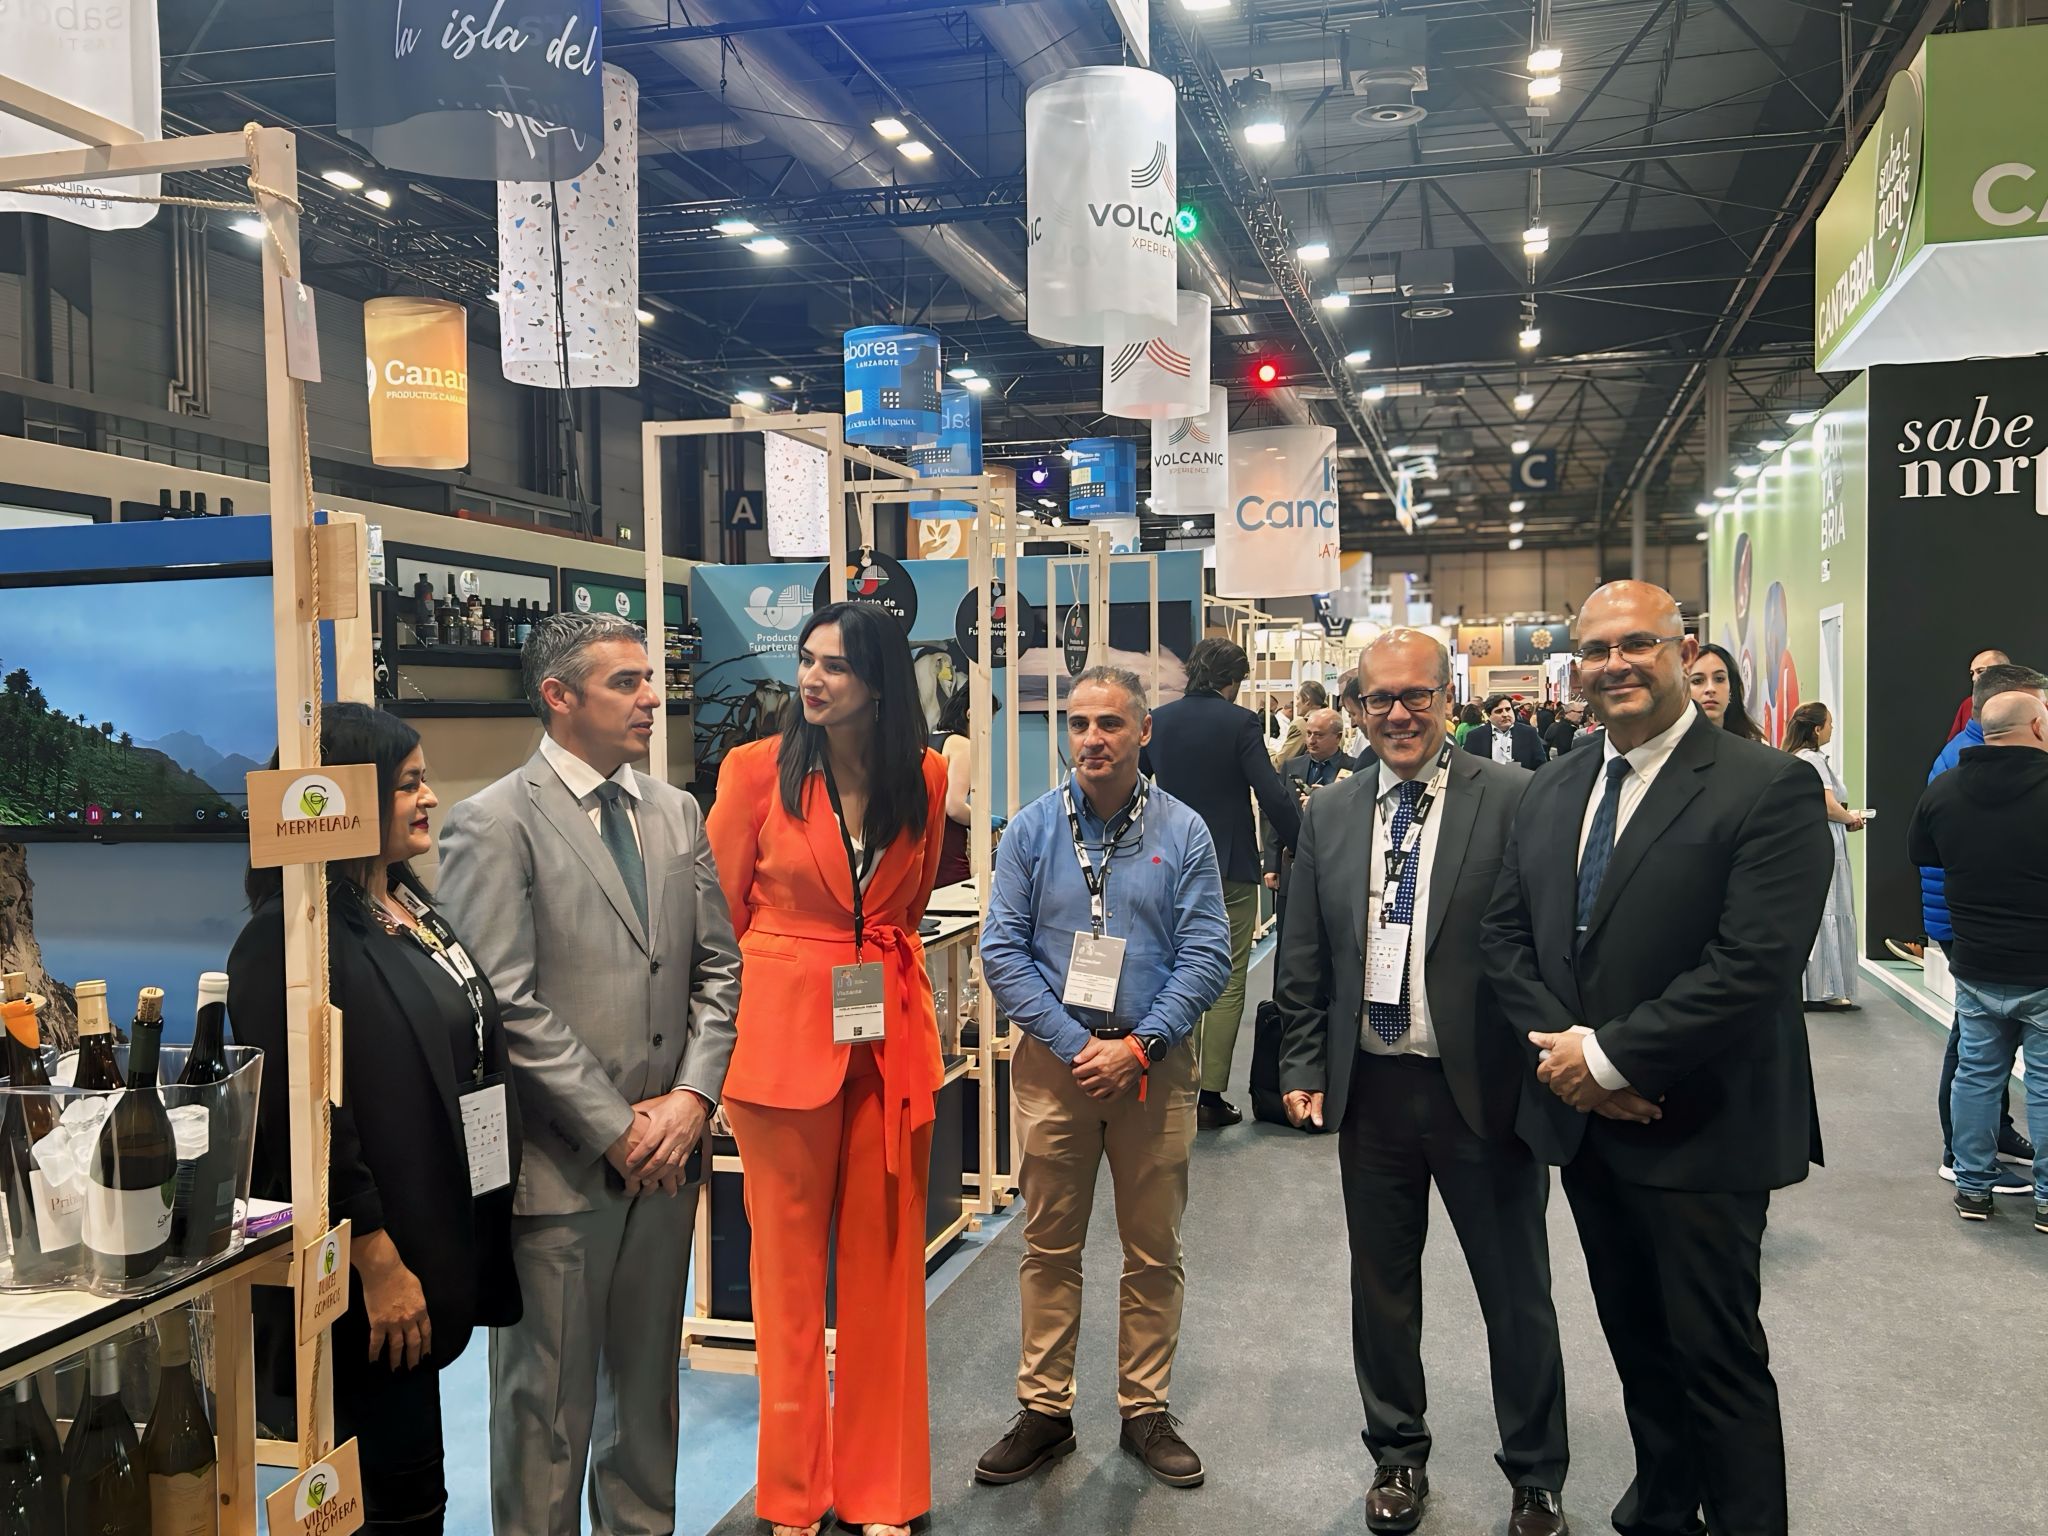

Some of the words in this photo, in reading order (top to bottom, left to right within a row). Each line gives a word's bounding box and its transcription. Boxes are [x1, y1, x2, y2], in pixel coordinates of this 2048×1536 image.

[441, 0, 529, 60] isla
[546, 15, 598, 75] del
[1972, 163, 2048, 226] C
[1088, 204, 1175, 241] VOLCA
[1818, 236, 1875, 349] CANTABRIA
[856, 360, 900, 369] LANZAROTE
[1897, 395, 2034, 453] sabe
[1154, 451, 1224, 468] VOLCANIC
[1521, 455, 1547, 488] C
[731, 496, 757, 524] A
[1821, 502, 1846, 552] BRIA
[883, 597, 896, 607] de
[276, 815, 361, 838] MERMELADA
[303, 1496, 337, 1530] VINOS
